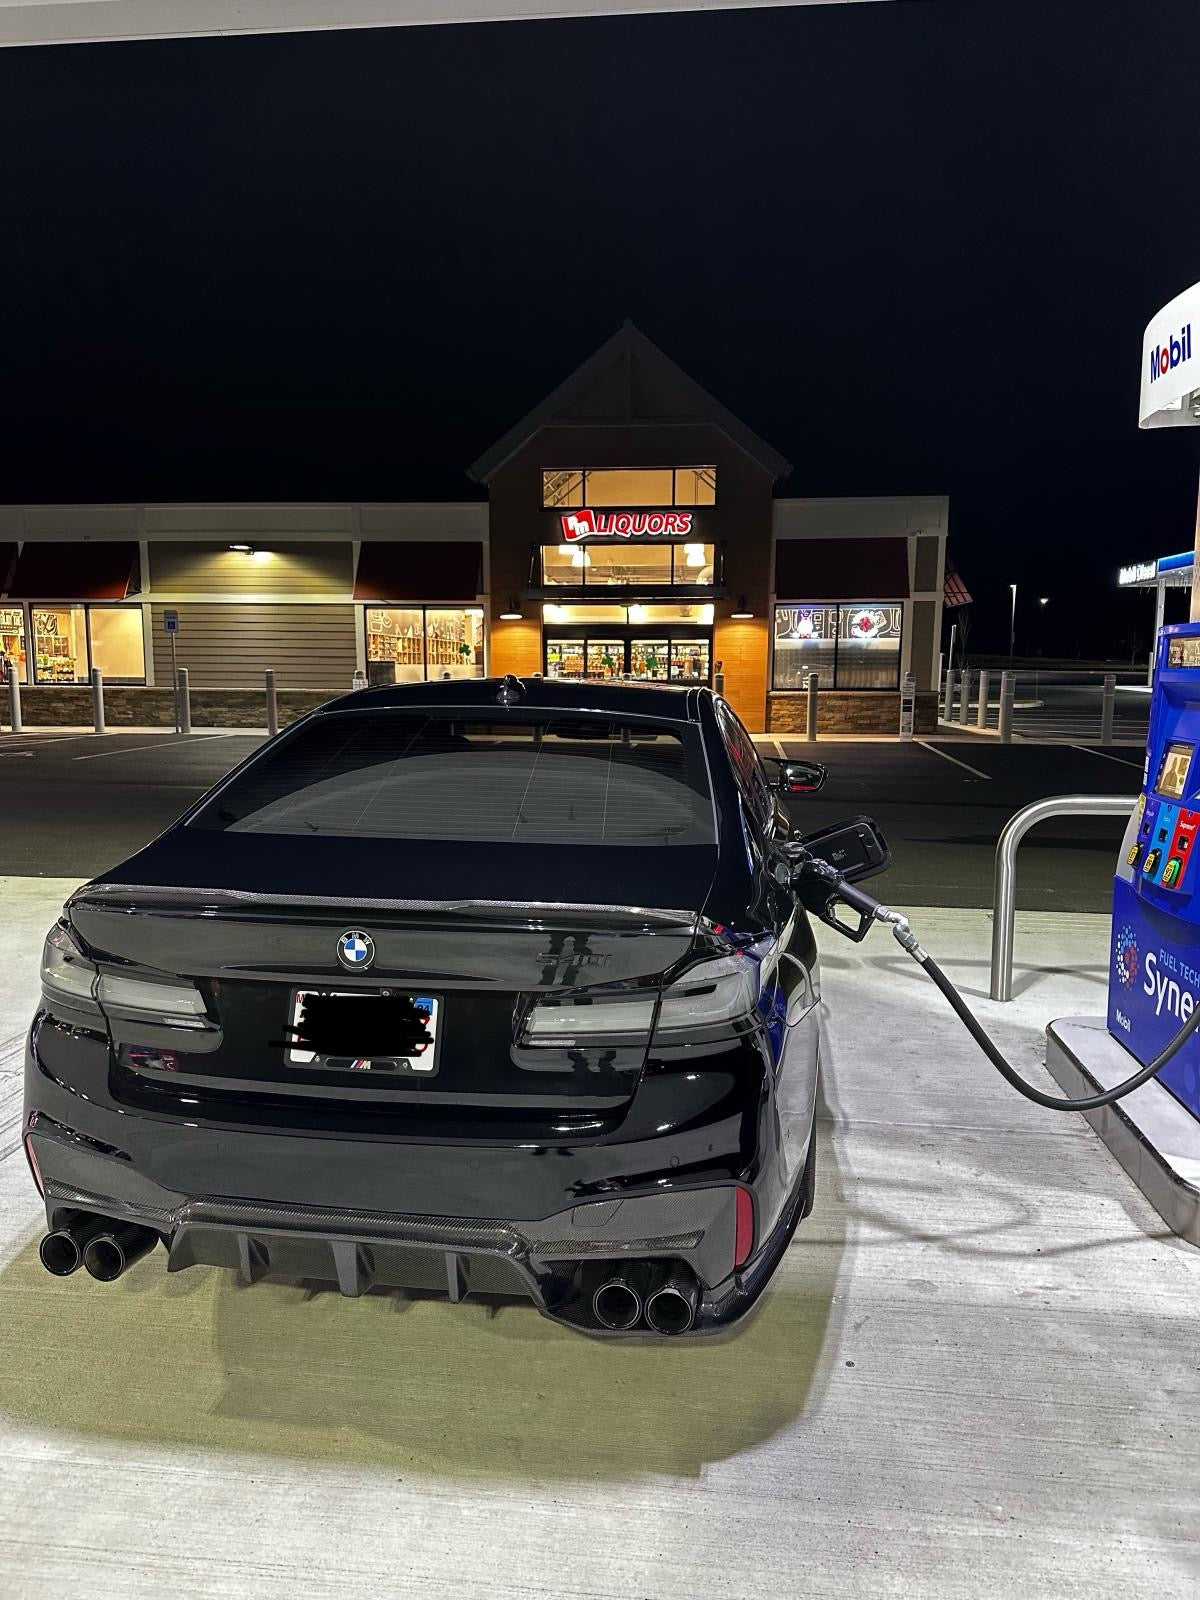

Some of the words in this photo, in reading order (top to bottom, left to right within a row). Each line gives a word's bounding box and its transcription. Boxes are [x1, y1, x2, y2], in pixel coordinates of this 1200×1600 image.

[1151, 323, 1191, 384] Mobil
[596, 512, 692, 538] LIQUORS
[340, 932, 371, 945] BMW
[1160, 948, 1177, 973] FUEL
[1179, 962, 1200, 989] TECH
[1144, 952, 1200, 1033] Syne
[1116, 1008, 1131, 1033] Mobil
